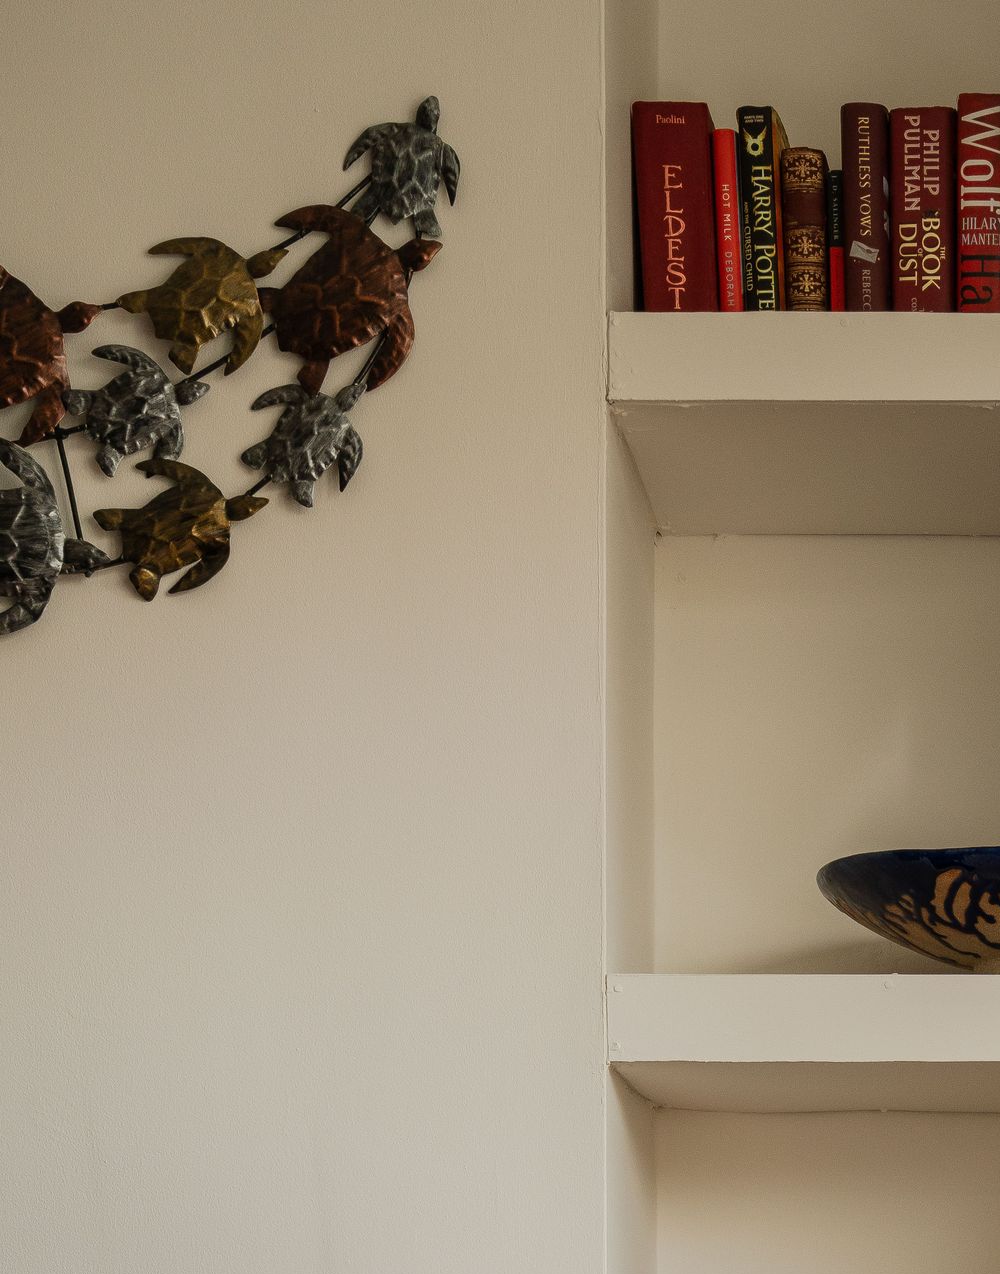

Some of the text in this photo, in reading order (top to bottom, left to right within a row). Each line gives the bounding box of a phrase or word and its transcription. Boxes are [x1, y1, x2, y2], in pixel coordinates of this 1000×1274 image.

[656, 114, 685, 125] Paolini
[857, 116, 872, 236] RUTHLESS VOWS
[903, 115, 921, 211] PULLMAN
[923, 129, 940, 196] PHILIP
[721, 184, 732, 241] HOT MILK
[751, 165, 774, 237] HARRY
[662, 164, 687, 310] ELDEST
[744, 226, 752, 260] CURSED
[899, 223, 918, 286] DUST
[921, 217, 941, 291] BOOK
[724, 251, 735, 307] DEBORAH
